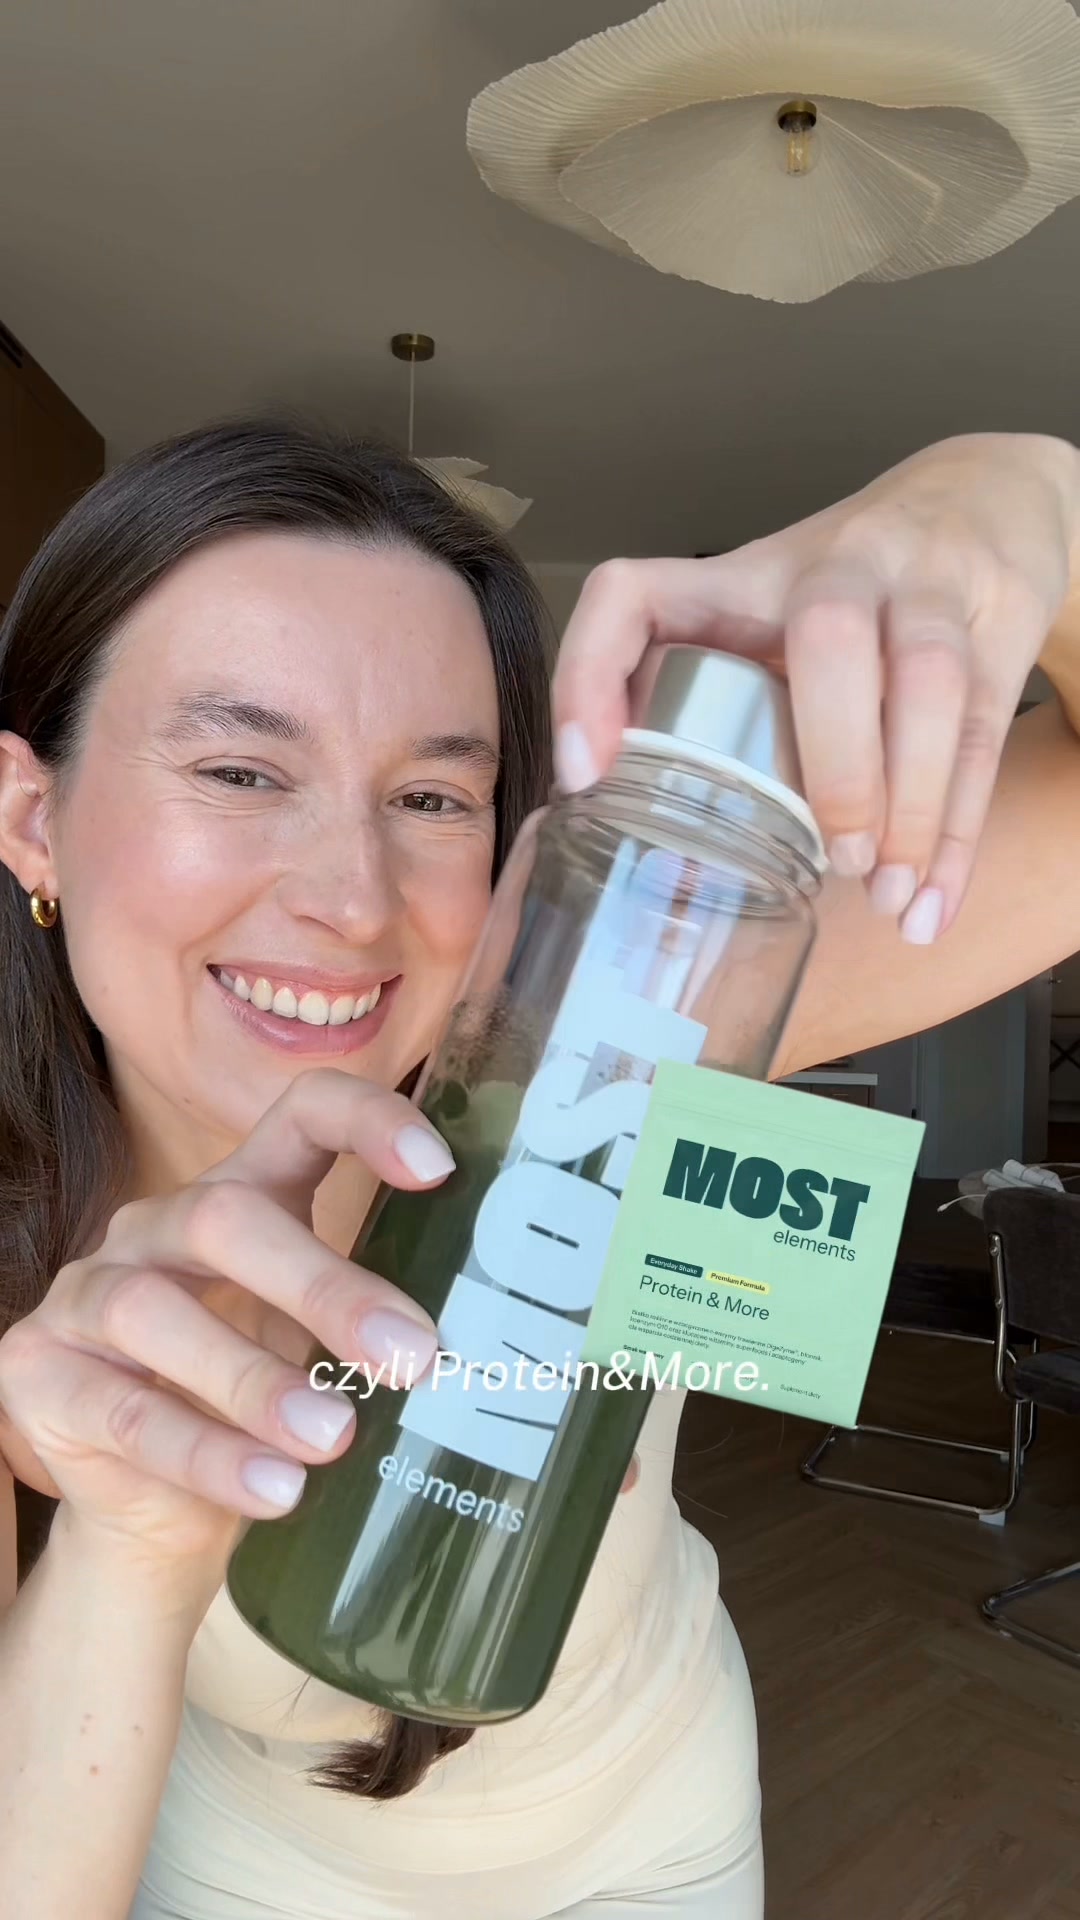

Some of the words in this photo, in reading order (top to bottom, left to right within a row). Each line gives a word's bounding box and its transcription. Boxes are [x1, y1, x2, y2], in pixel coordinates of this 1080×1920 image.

[662, 1137, 871, 1242] MOST
[773, 1229, 856, 1262] elements
[650, 1257, 678, 1272] Everyday
[678, 1264, 698, 1275] Shake
[710, 1272, 740, 1285] Premium
[739, 1279, 766, 1292] Formula
[639, 1274, 703, 1305] Protein
[706, 1291, 720, 1309] &
[724, 1295, 770, 1321] More
[378, 1454, 525, 1533] elements
